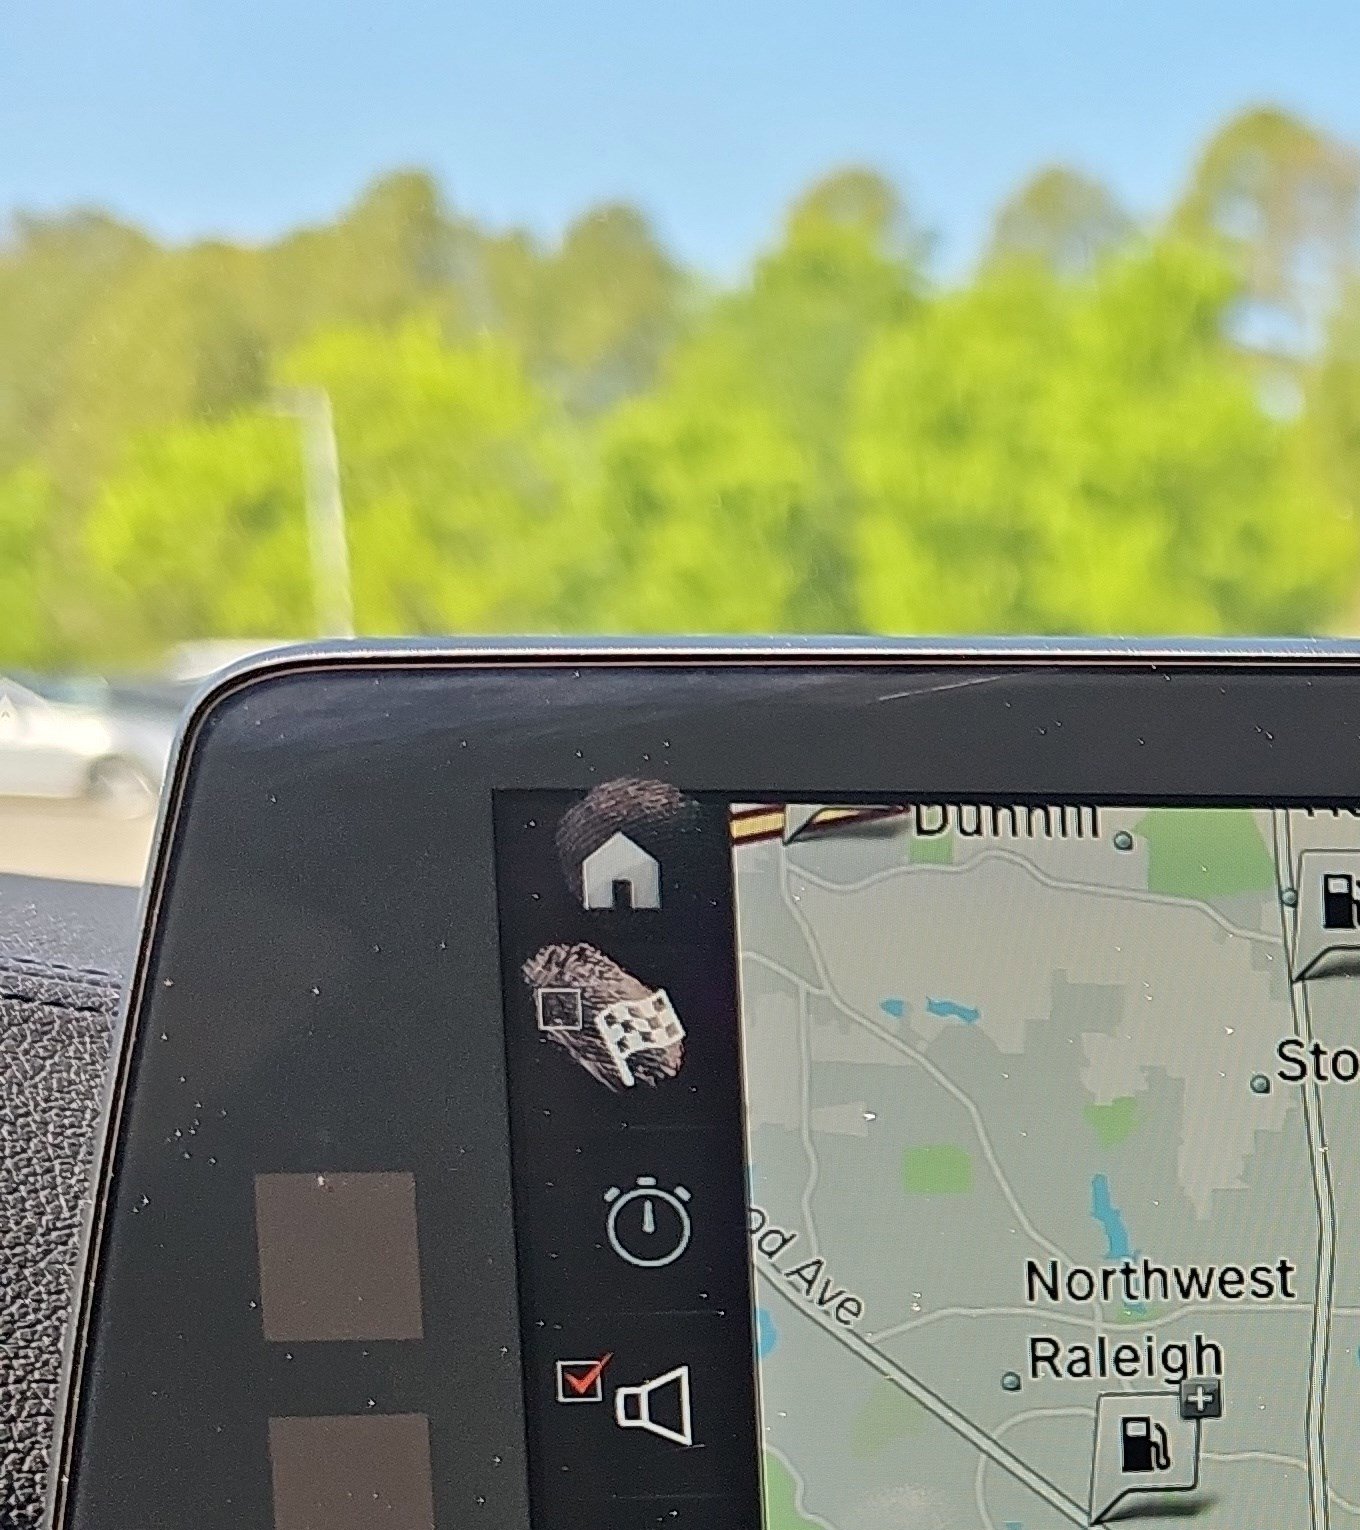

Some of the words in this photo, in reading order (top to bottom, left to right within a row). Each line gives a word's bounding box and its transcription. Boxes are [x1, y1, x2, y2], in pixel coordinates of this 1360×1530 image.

[783, 1258, 863, 1326] Ave
[1025, 1258, 1298, 1302] Northwest
[1028, 1333, 1223, 1382] Raleigh
